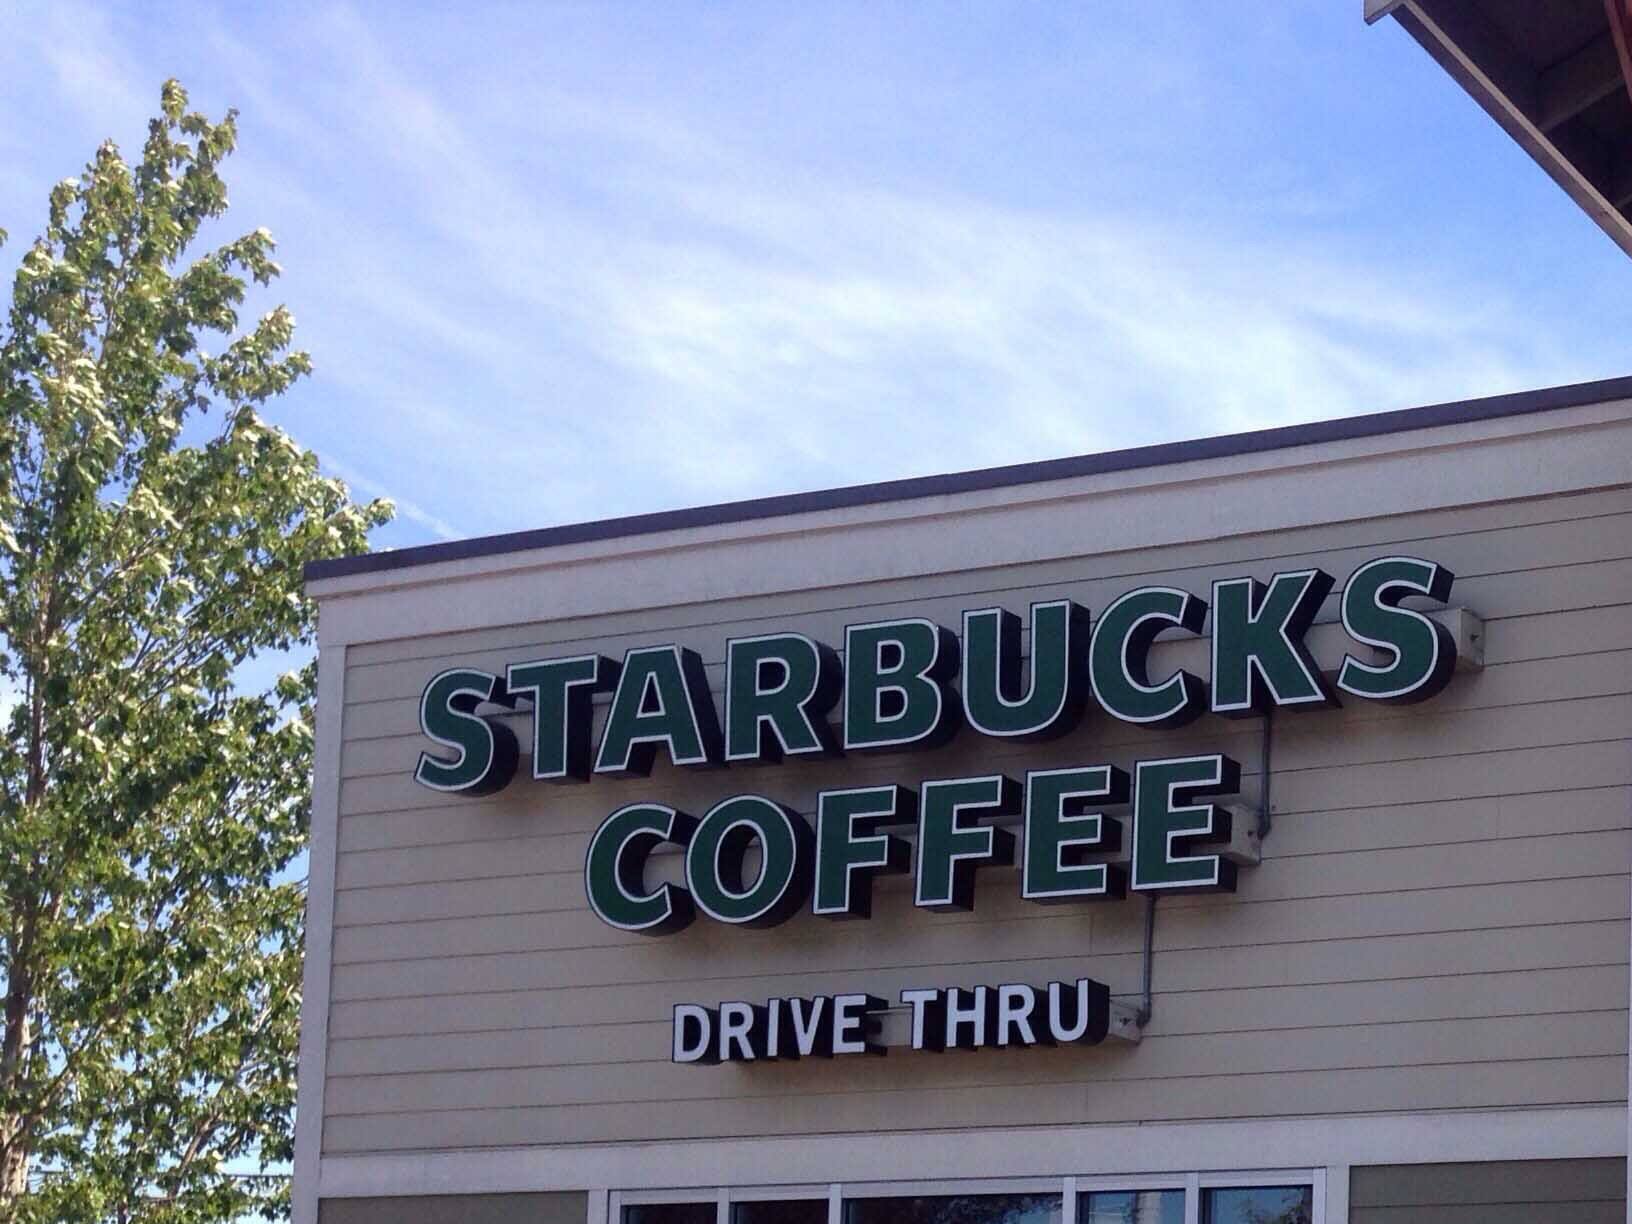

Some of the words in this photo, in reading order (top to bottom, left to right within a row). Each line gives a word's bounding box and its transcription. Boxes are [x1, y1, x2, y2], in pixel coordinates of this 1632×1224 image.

[413, 556, 1454, 795] STARBUCKS
[584, 753, 1233, 933] COFFEE
[672, 997, 875, 1064] DRIVE
[901, 978, 1096, 1052] THRU
